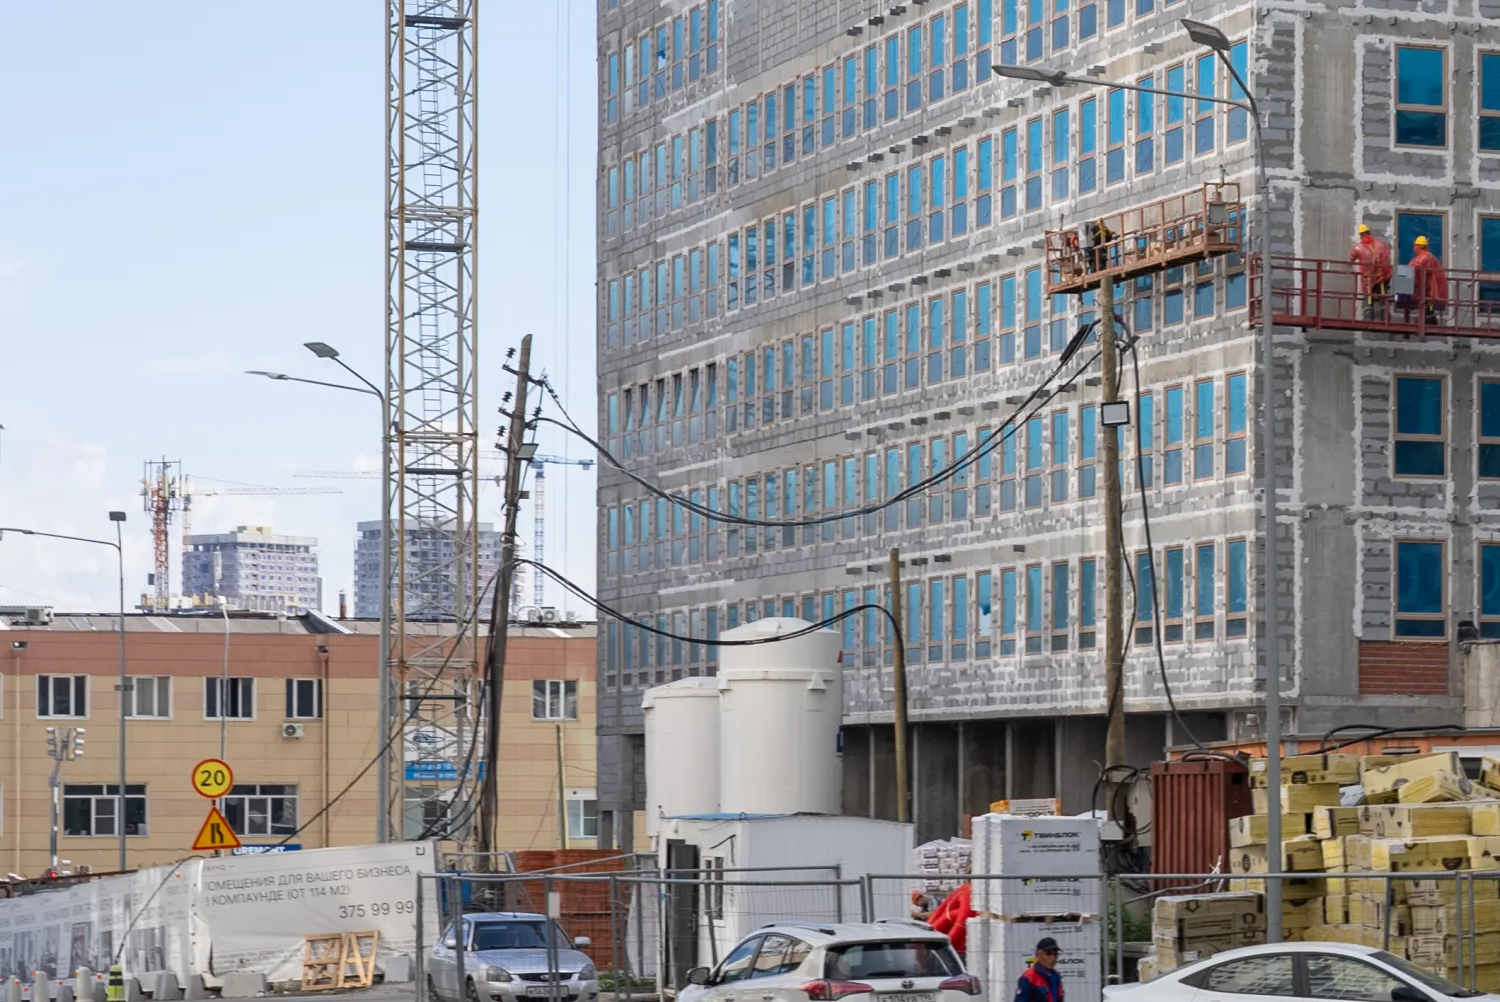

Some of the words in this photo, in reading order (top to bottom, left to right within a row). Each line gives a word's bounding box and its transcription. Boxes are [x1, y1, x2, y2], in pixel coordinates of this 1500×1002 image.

[200, 770, 225, 786] 20
[205, 875, 275, 891] ОМЕЩЕНИЯ
[277, 873, 303, 886] ДЛЯ
[306, 869, 353, 884] ВАШЕГО
[356, 865, 411, 879] БИЗНЕСА
[211, 889, 285, 906] КОМПАУНДЕ
[310, 886, 326, 898] 114
[338, 904, 366, 919] 375
[371, 902, 390, 916] 99
[395, 900, 414, 914] 99
